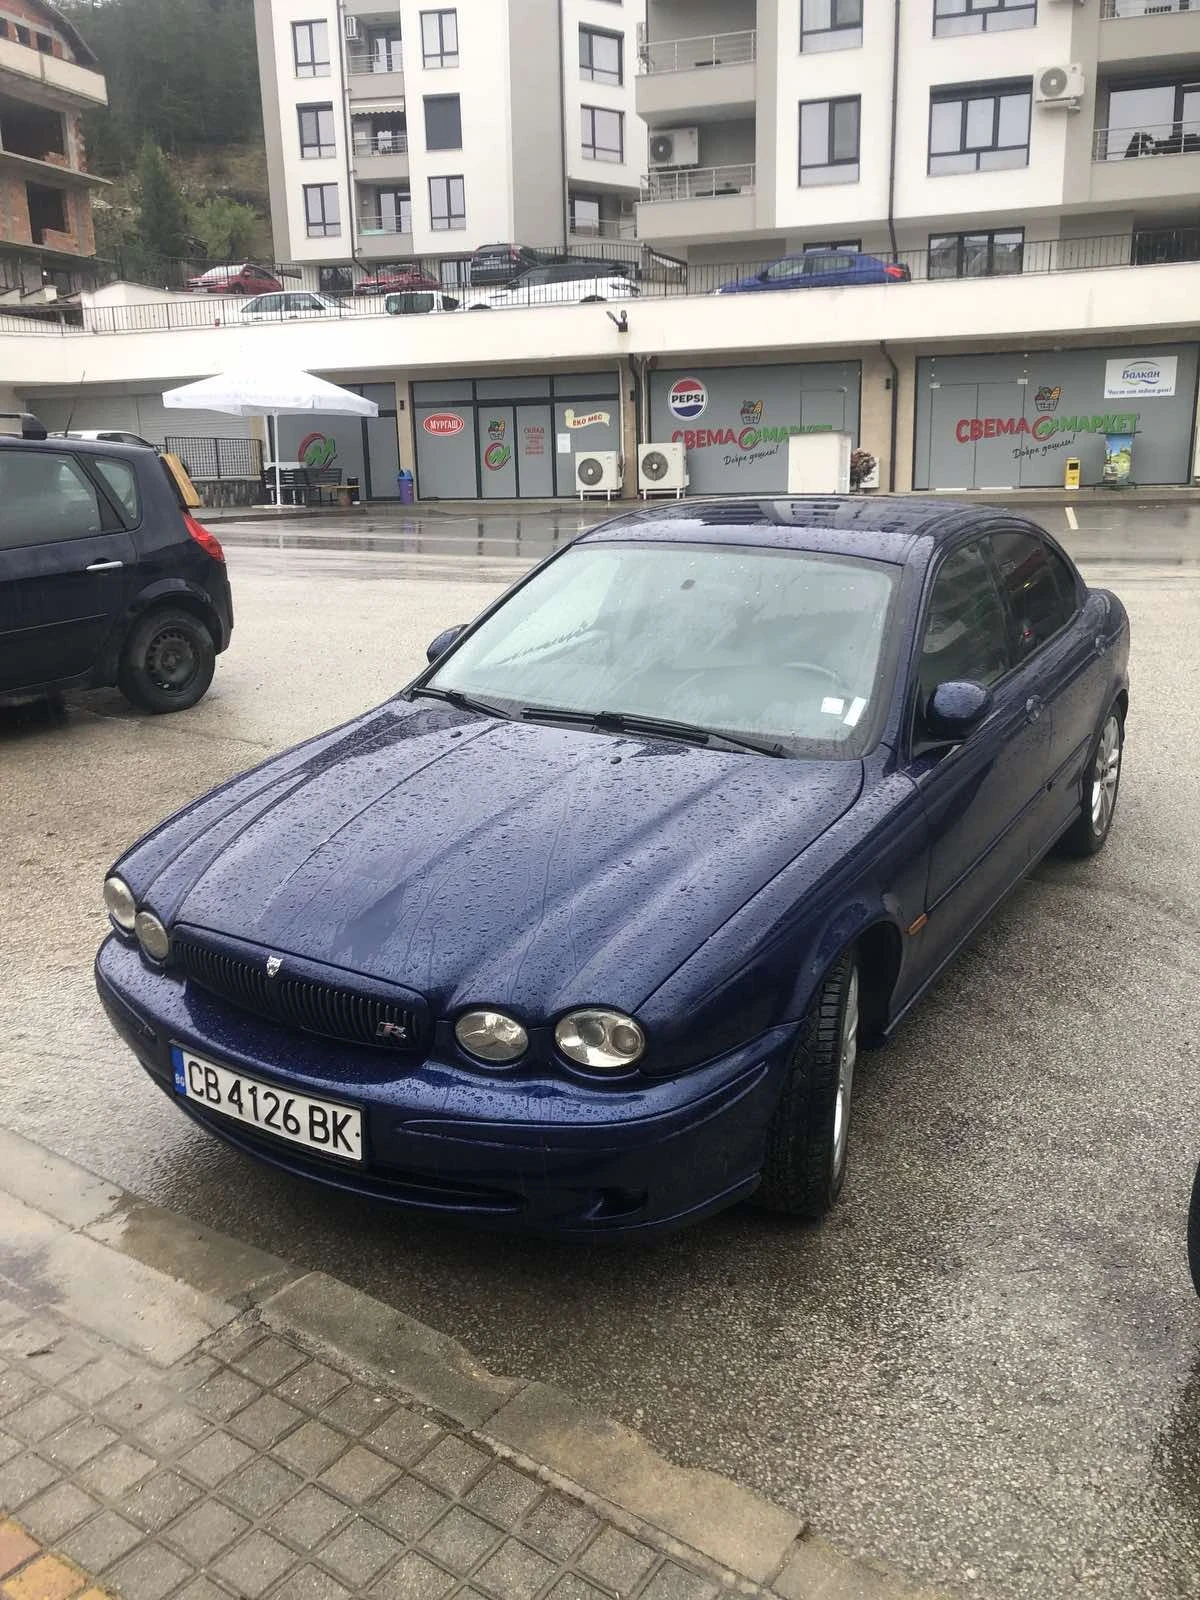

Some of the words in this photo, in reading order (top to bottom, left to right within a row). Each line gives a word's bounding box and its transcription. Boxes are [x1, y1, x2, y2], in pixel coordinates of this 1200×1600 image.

[1122, 370, 1160, 380] Балкан
[671, 394, 705, 403] PEPSI
[430, 420, 459, 430] МУРГАШ
[227, 1080, 301, 1135] 4126
